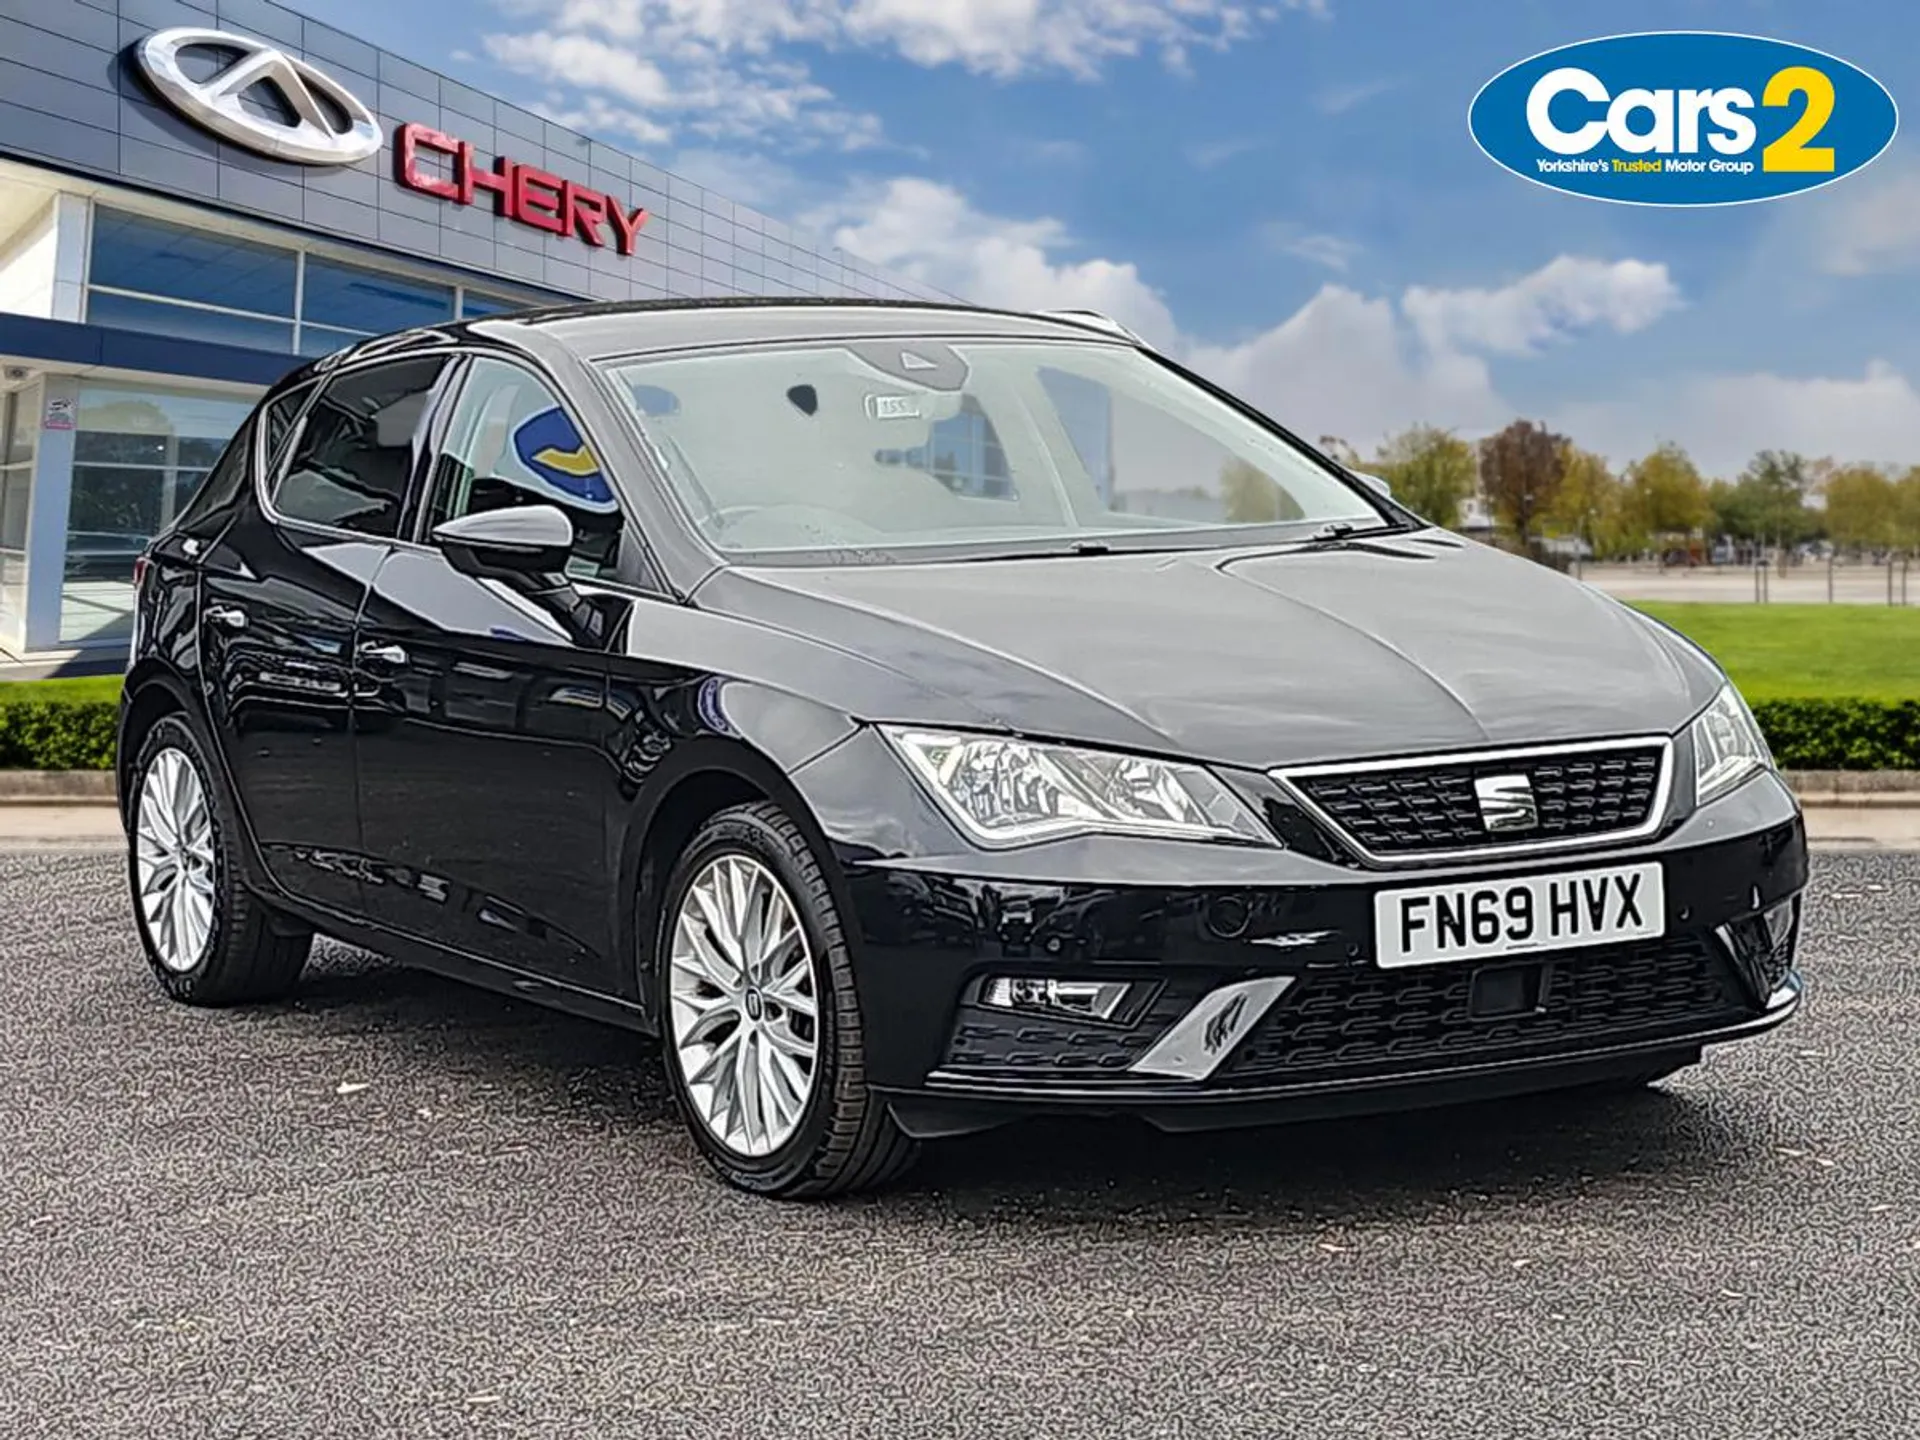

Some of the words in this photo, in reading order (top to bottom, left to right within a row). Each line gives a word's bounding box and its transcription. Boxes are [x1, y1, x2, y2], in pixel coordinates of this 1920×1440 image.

[393, 122, 648, 255] CHERY
[1400, 886, 1534, 953] FN69
[1550, 873, 1643, 937] HVX
